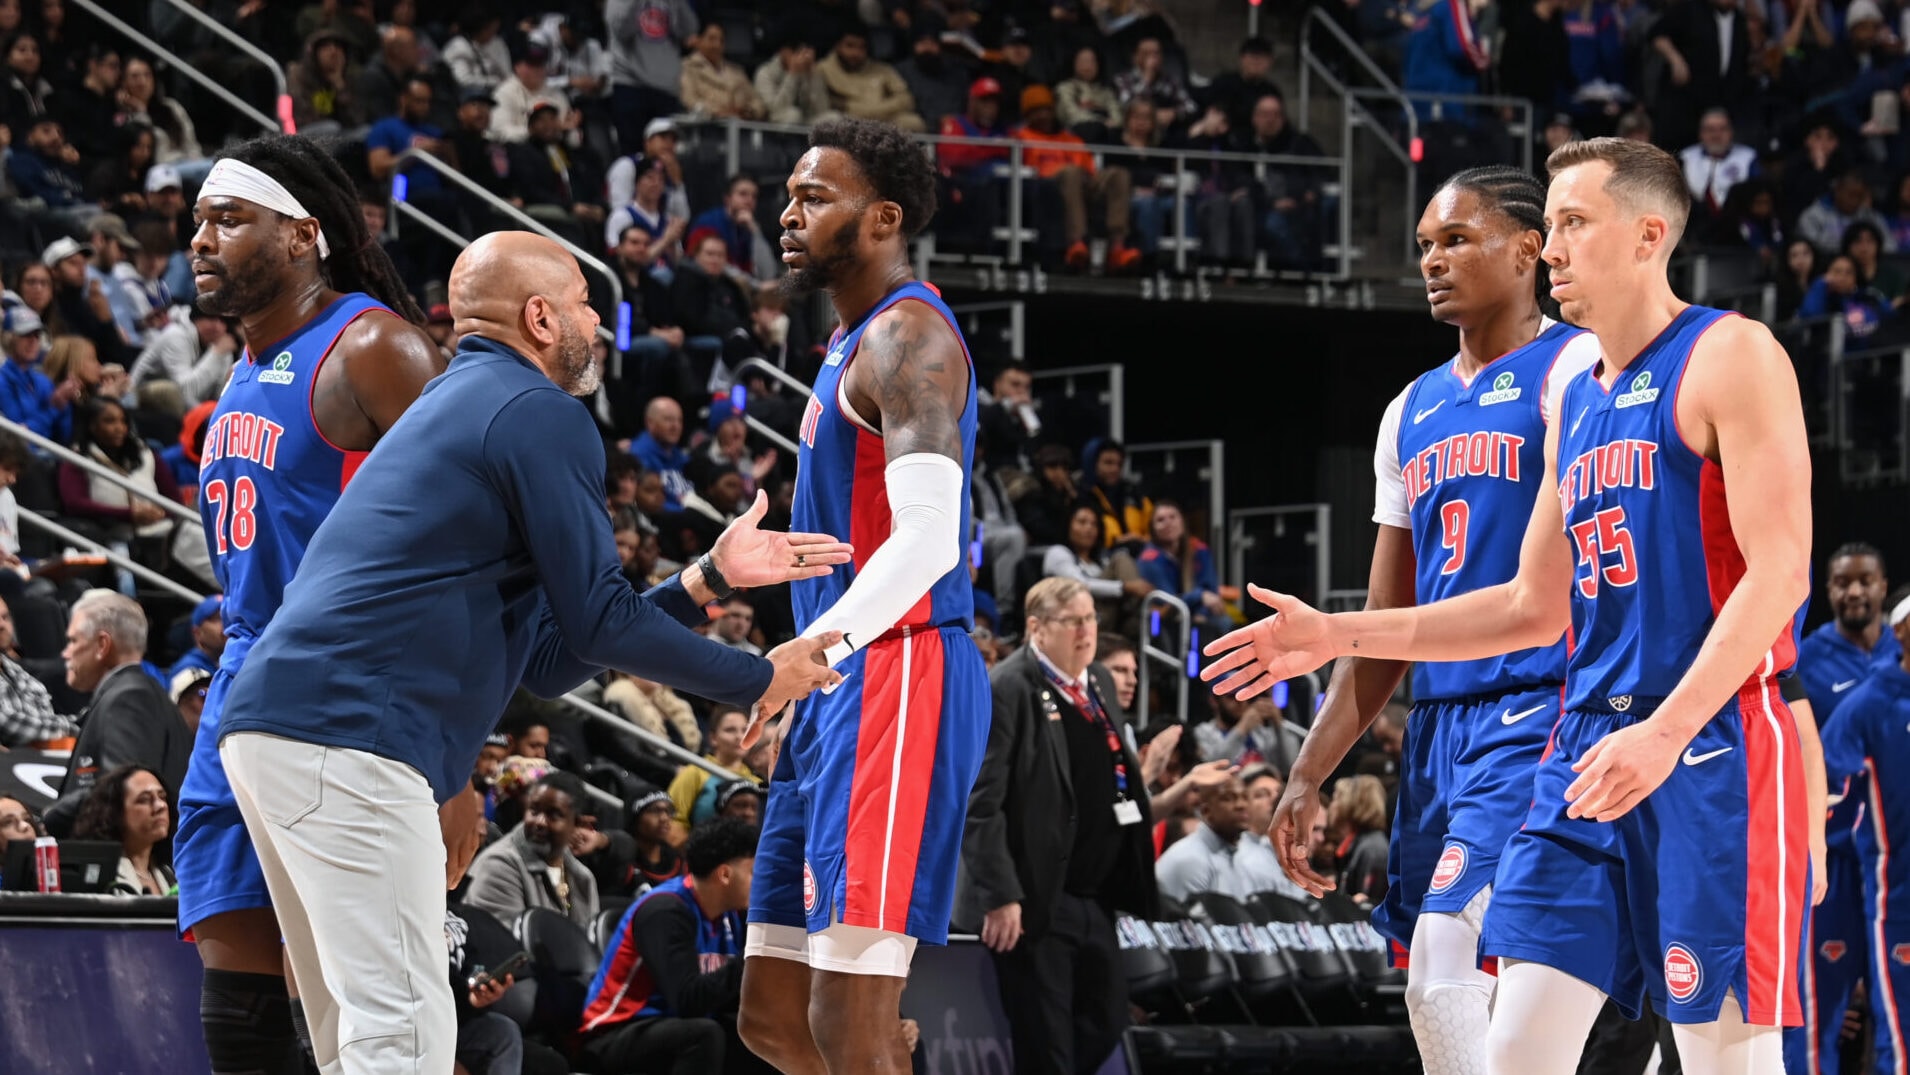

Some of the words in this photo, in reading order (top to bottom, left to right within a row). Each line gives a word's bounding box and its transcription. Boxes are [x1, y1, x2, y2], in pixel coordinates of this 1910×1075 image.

[1480, 389, 1519, 404] StockX
[1617, 388, 1658, 406] StockX
[200, 411, 285, 475] ETROIT
[1401, 431, 1525, 512] DETROIT
[205, 476, 257, 556] 28
[1440, 499, 1470, 575] 9
[1570, 505, 1638, 599] 55
